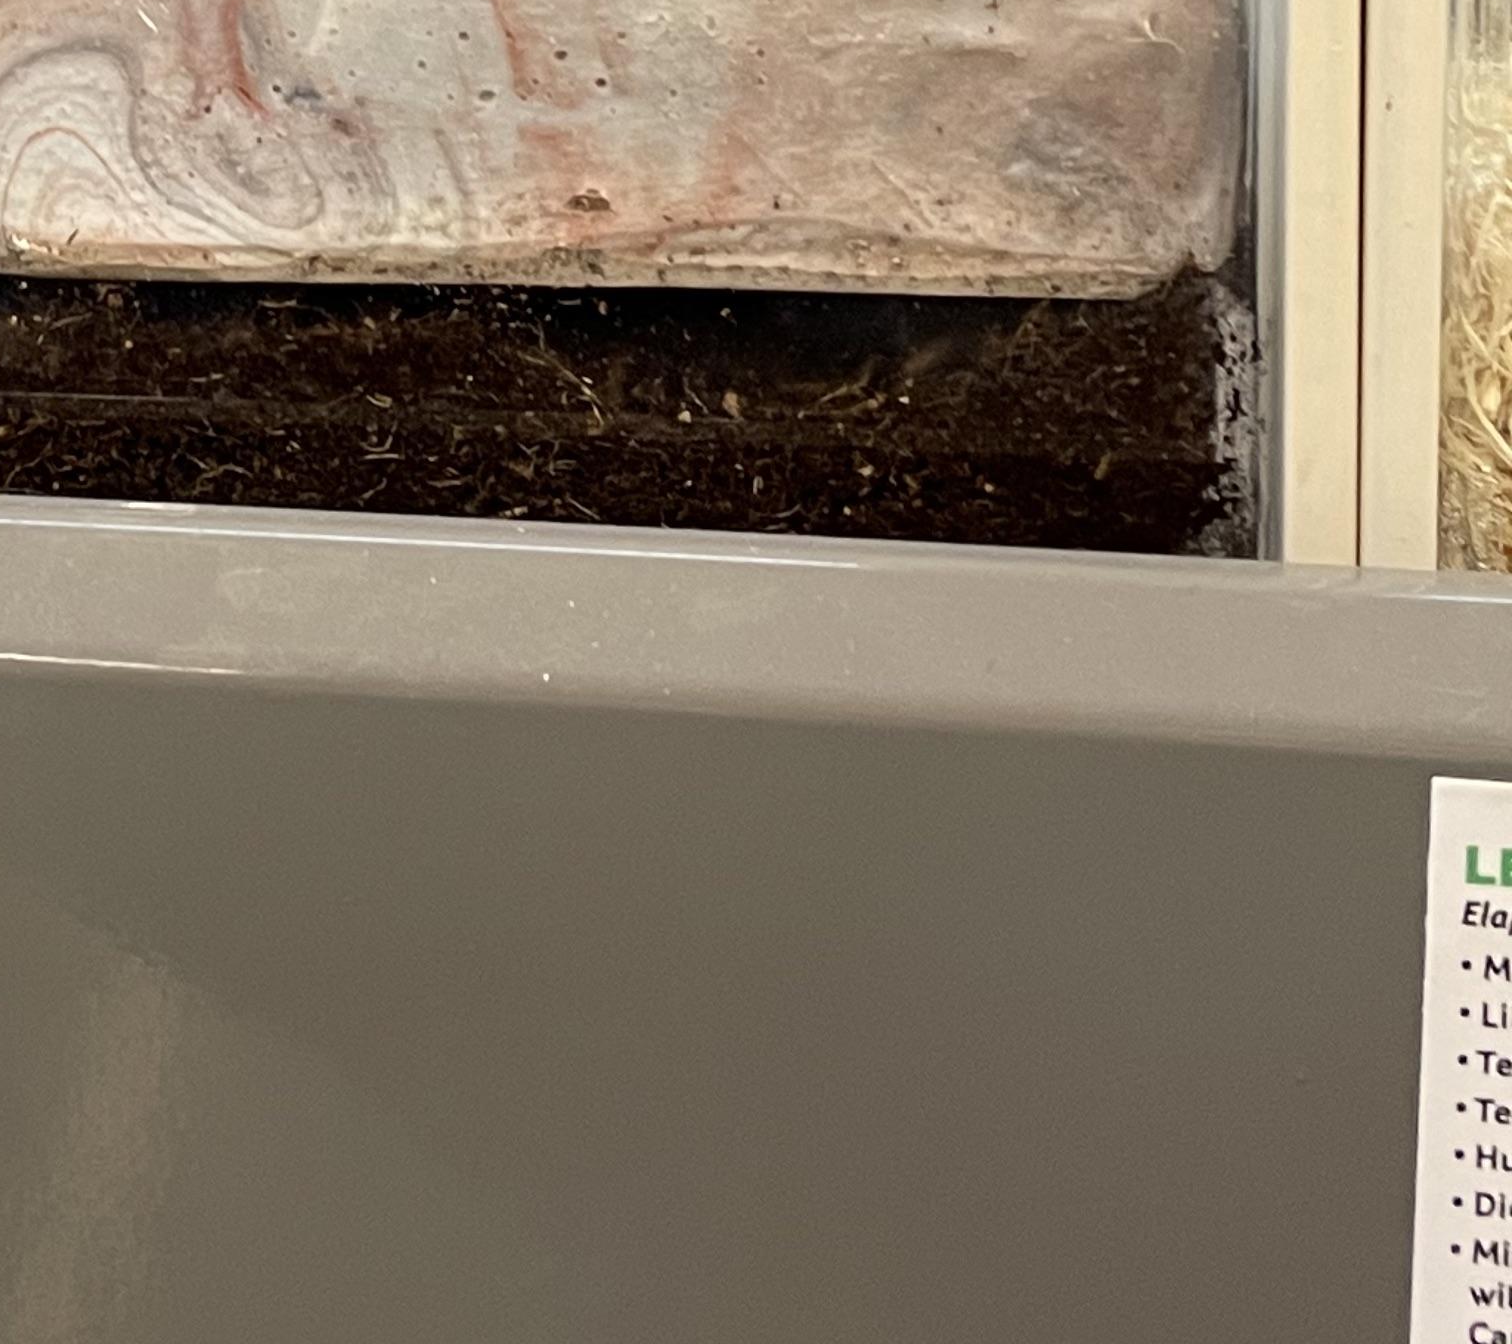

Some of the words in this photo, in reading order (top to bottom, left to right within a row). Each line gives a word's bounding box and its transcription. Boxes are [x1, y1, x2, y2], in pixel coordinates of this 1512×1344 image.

[1462, 900, 1512, 936] Ela
[1476, 1050, 1512, 1077] Te
[1474, 1097, 1512, 1125] Te
[1475, 1191, 1512, 1219] Di
[1473, 1238, 1511, 1267] Mi
